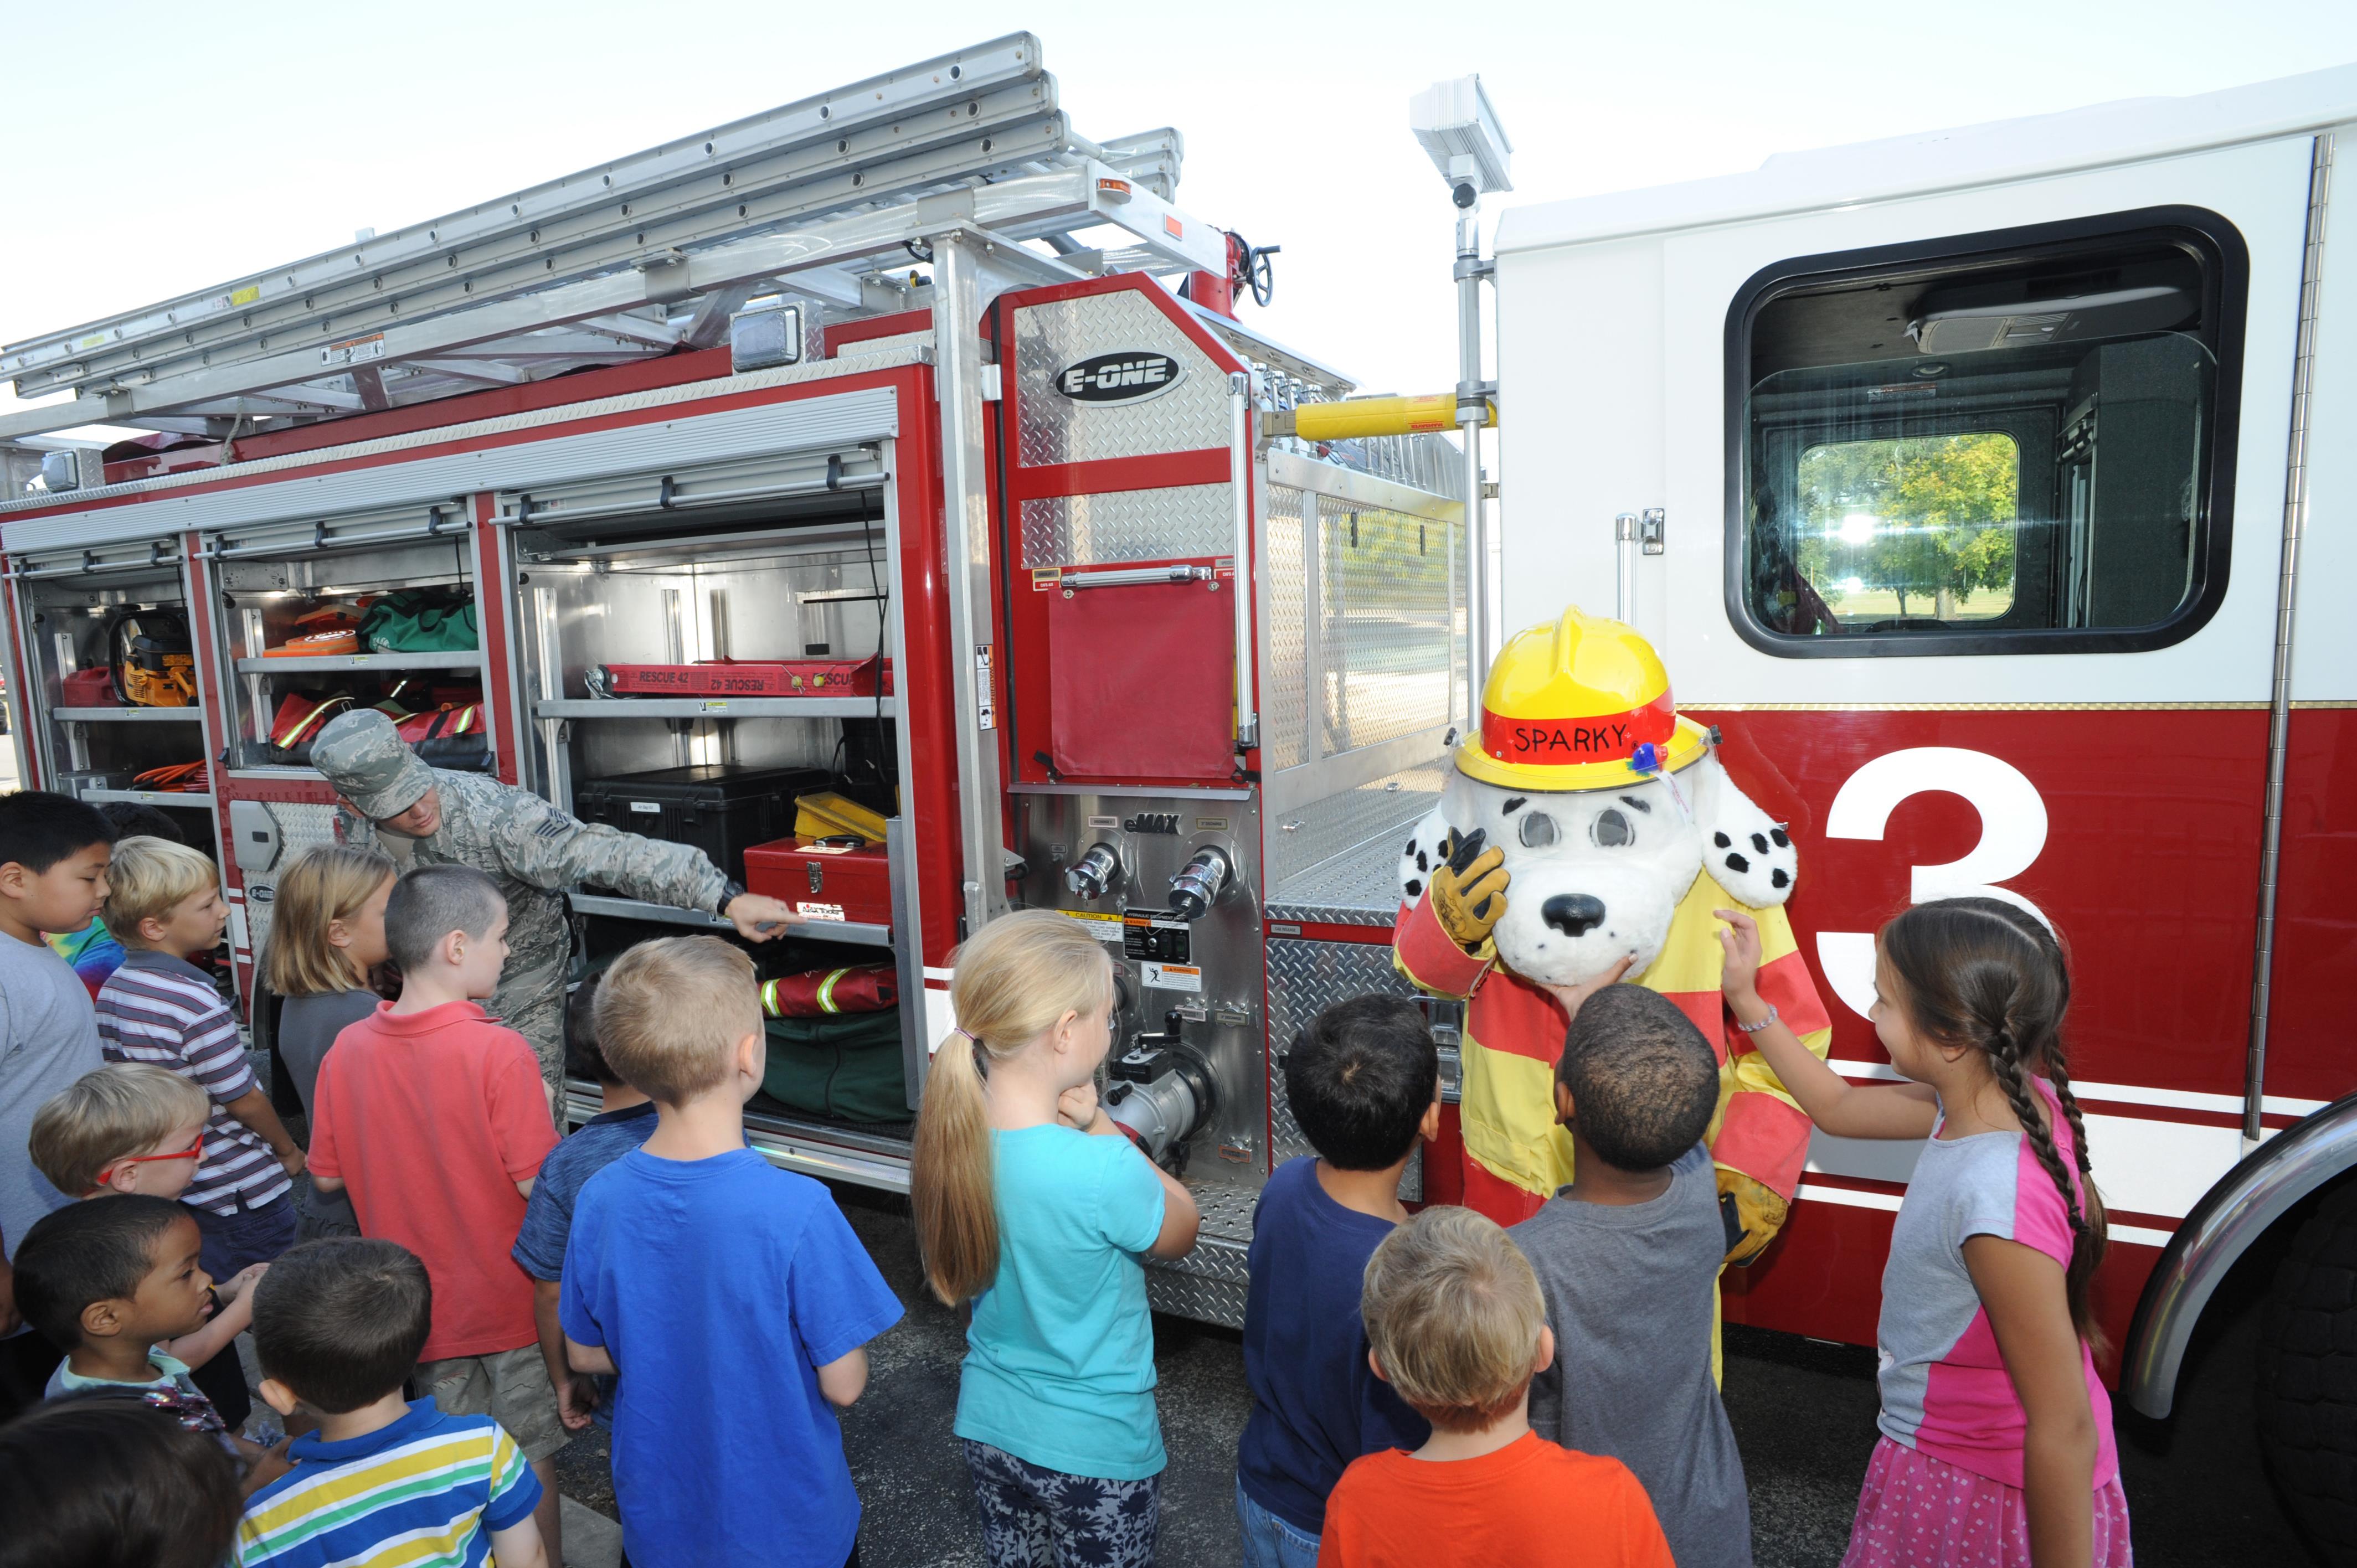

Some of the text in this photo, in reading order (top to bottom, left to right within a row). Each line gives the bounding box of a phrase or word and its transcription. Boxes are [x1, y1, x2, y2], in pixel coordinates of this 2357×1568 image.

[1063, 358, 1167, 393] E-ONE
[639, 671, 676, 683] RESCUE
[677, 671, 689, 683] 42
[711, 679, 722, 690] 42
[724, 679, 764, 691] RESCUE
[1515, 724, 1627, 752] SPARKY
[1124, 813, 1181, 834] eMAX
[1816, 746, 2057, 1021] 3
